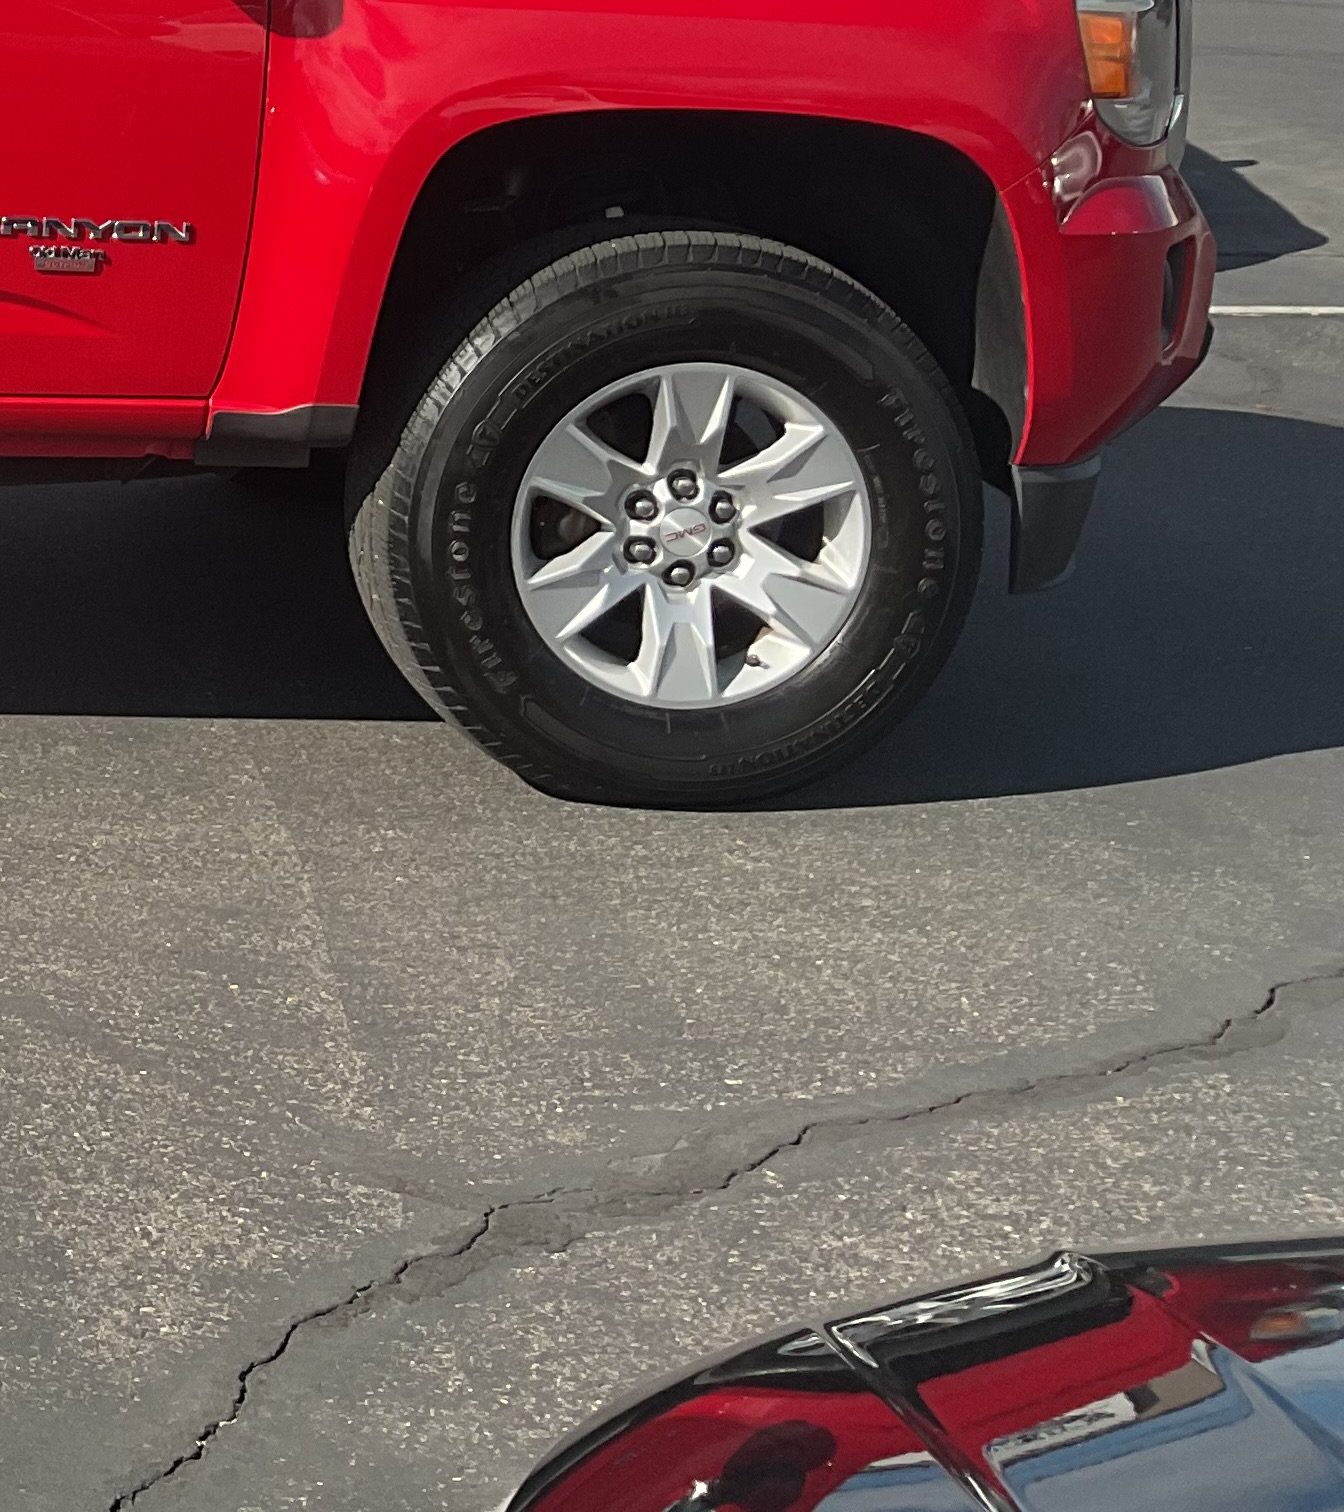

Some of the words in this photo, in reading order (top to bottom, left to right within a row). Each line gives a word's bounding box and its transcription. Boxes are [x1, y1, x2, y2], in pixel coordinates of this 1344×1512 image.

[446, 481, 517, 693] Firestone
[664, 522, 707, 543] GMC
[877, 389, 942, 595] Firestone
